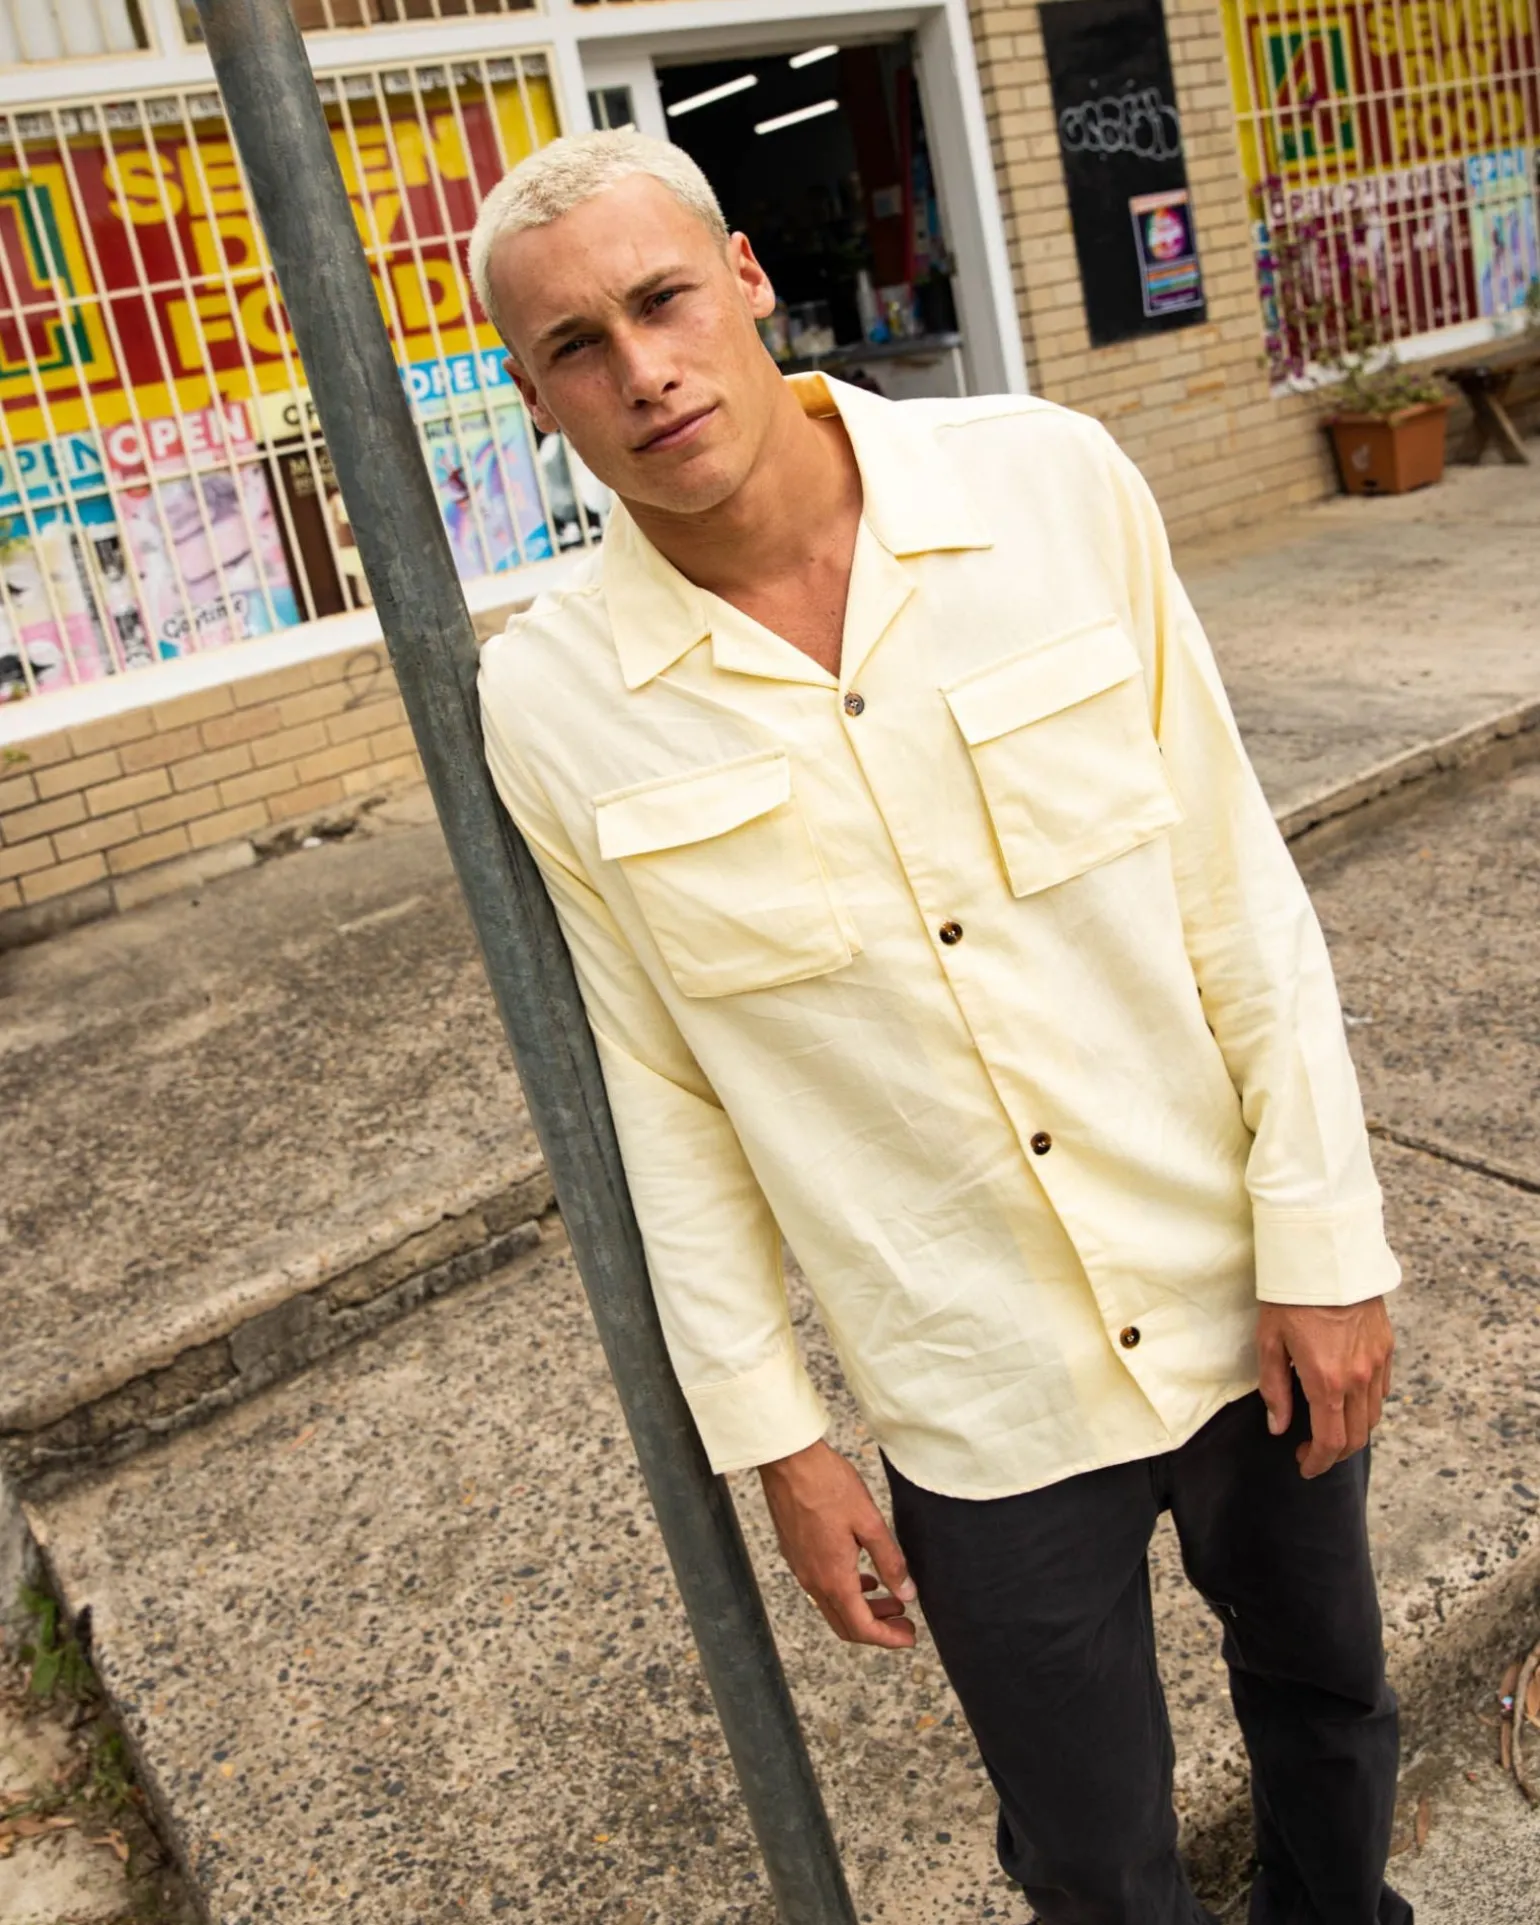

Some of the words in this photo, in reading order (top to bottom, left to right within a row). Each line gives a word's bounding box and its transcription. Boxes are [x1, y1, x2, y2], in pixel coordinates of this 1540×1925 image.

[1367, 0, 1533, 57] SEVEN
[1389, 86, 1528, 162] FOOD
[103, 113, 469, 225] SEEN
[190, 194, 403, 290] DY
[400, 355, 498, 400] OPEN
[108, 403, 248, 466] OPEN
